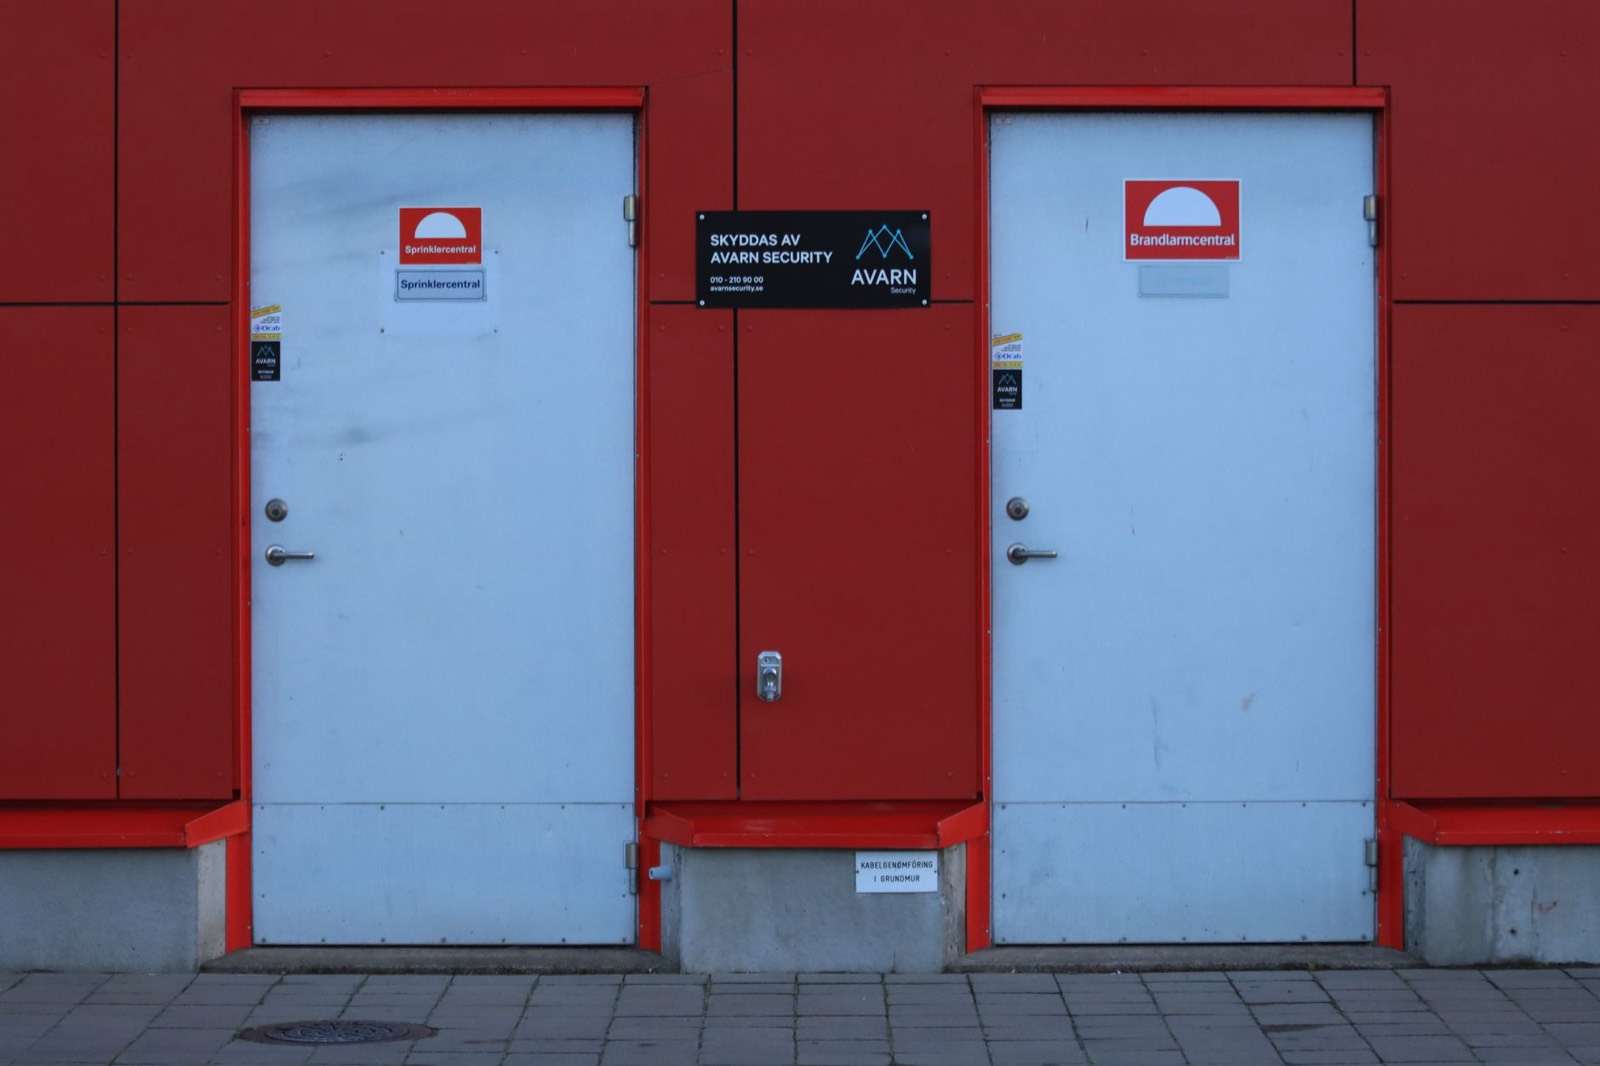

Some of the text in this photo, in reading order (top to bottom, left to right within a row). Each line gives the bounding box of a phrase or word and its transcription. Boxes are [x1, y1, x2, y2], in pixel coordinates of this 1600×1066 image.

[710, 234, 801, 247] SKYDDAS AV
[1130, 233, 1235, 247] Brandlarmcentral
[405, 245, 476, 256] Sprinklercentral
[710, 251, 833, 264] AVARN SECURITY
[710, 276, 723, 284] 010
[729, 276, 742, 284] 210
[743, 276, 752, 284] 90
[753, 276, 764, 284] 00
[851, 268, 917, 286] AVARN
[400, 279, 481, 290] Sprinklercentral
[710, 285, 764, 293] avarnsecurity.se
[890, 286, 917, 295] Security
[860, 861, 933, 870] KABELGENOMFÖRING
[880, 875, 920, 883] GRUNDMUR
